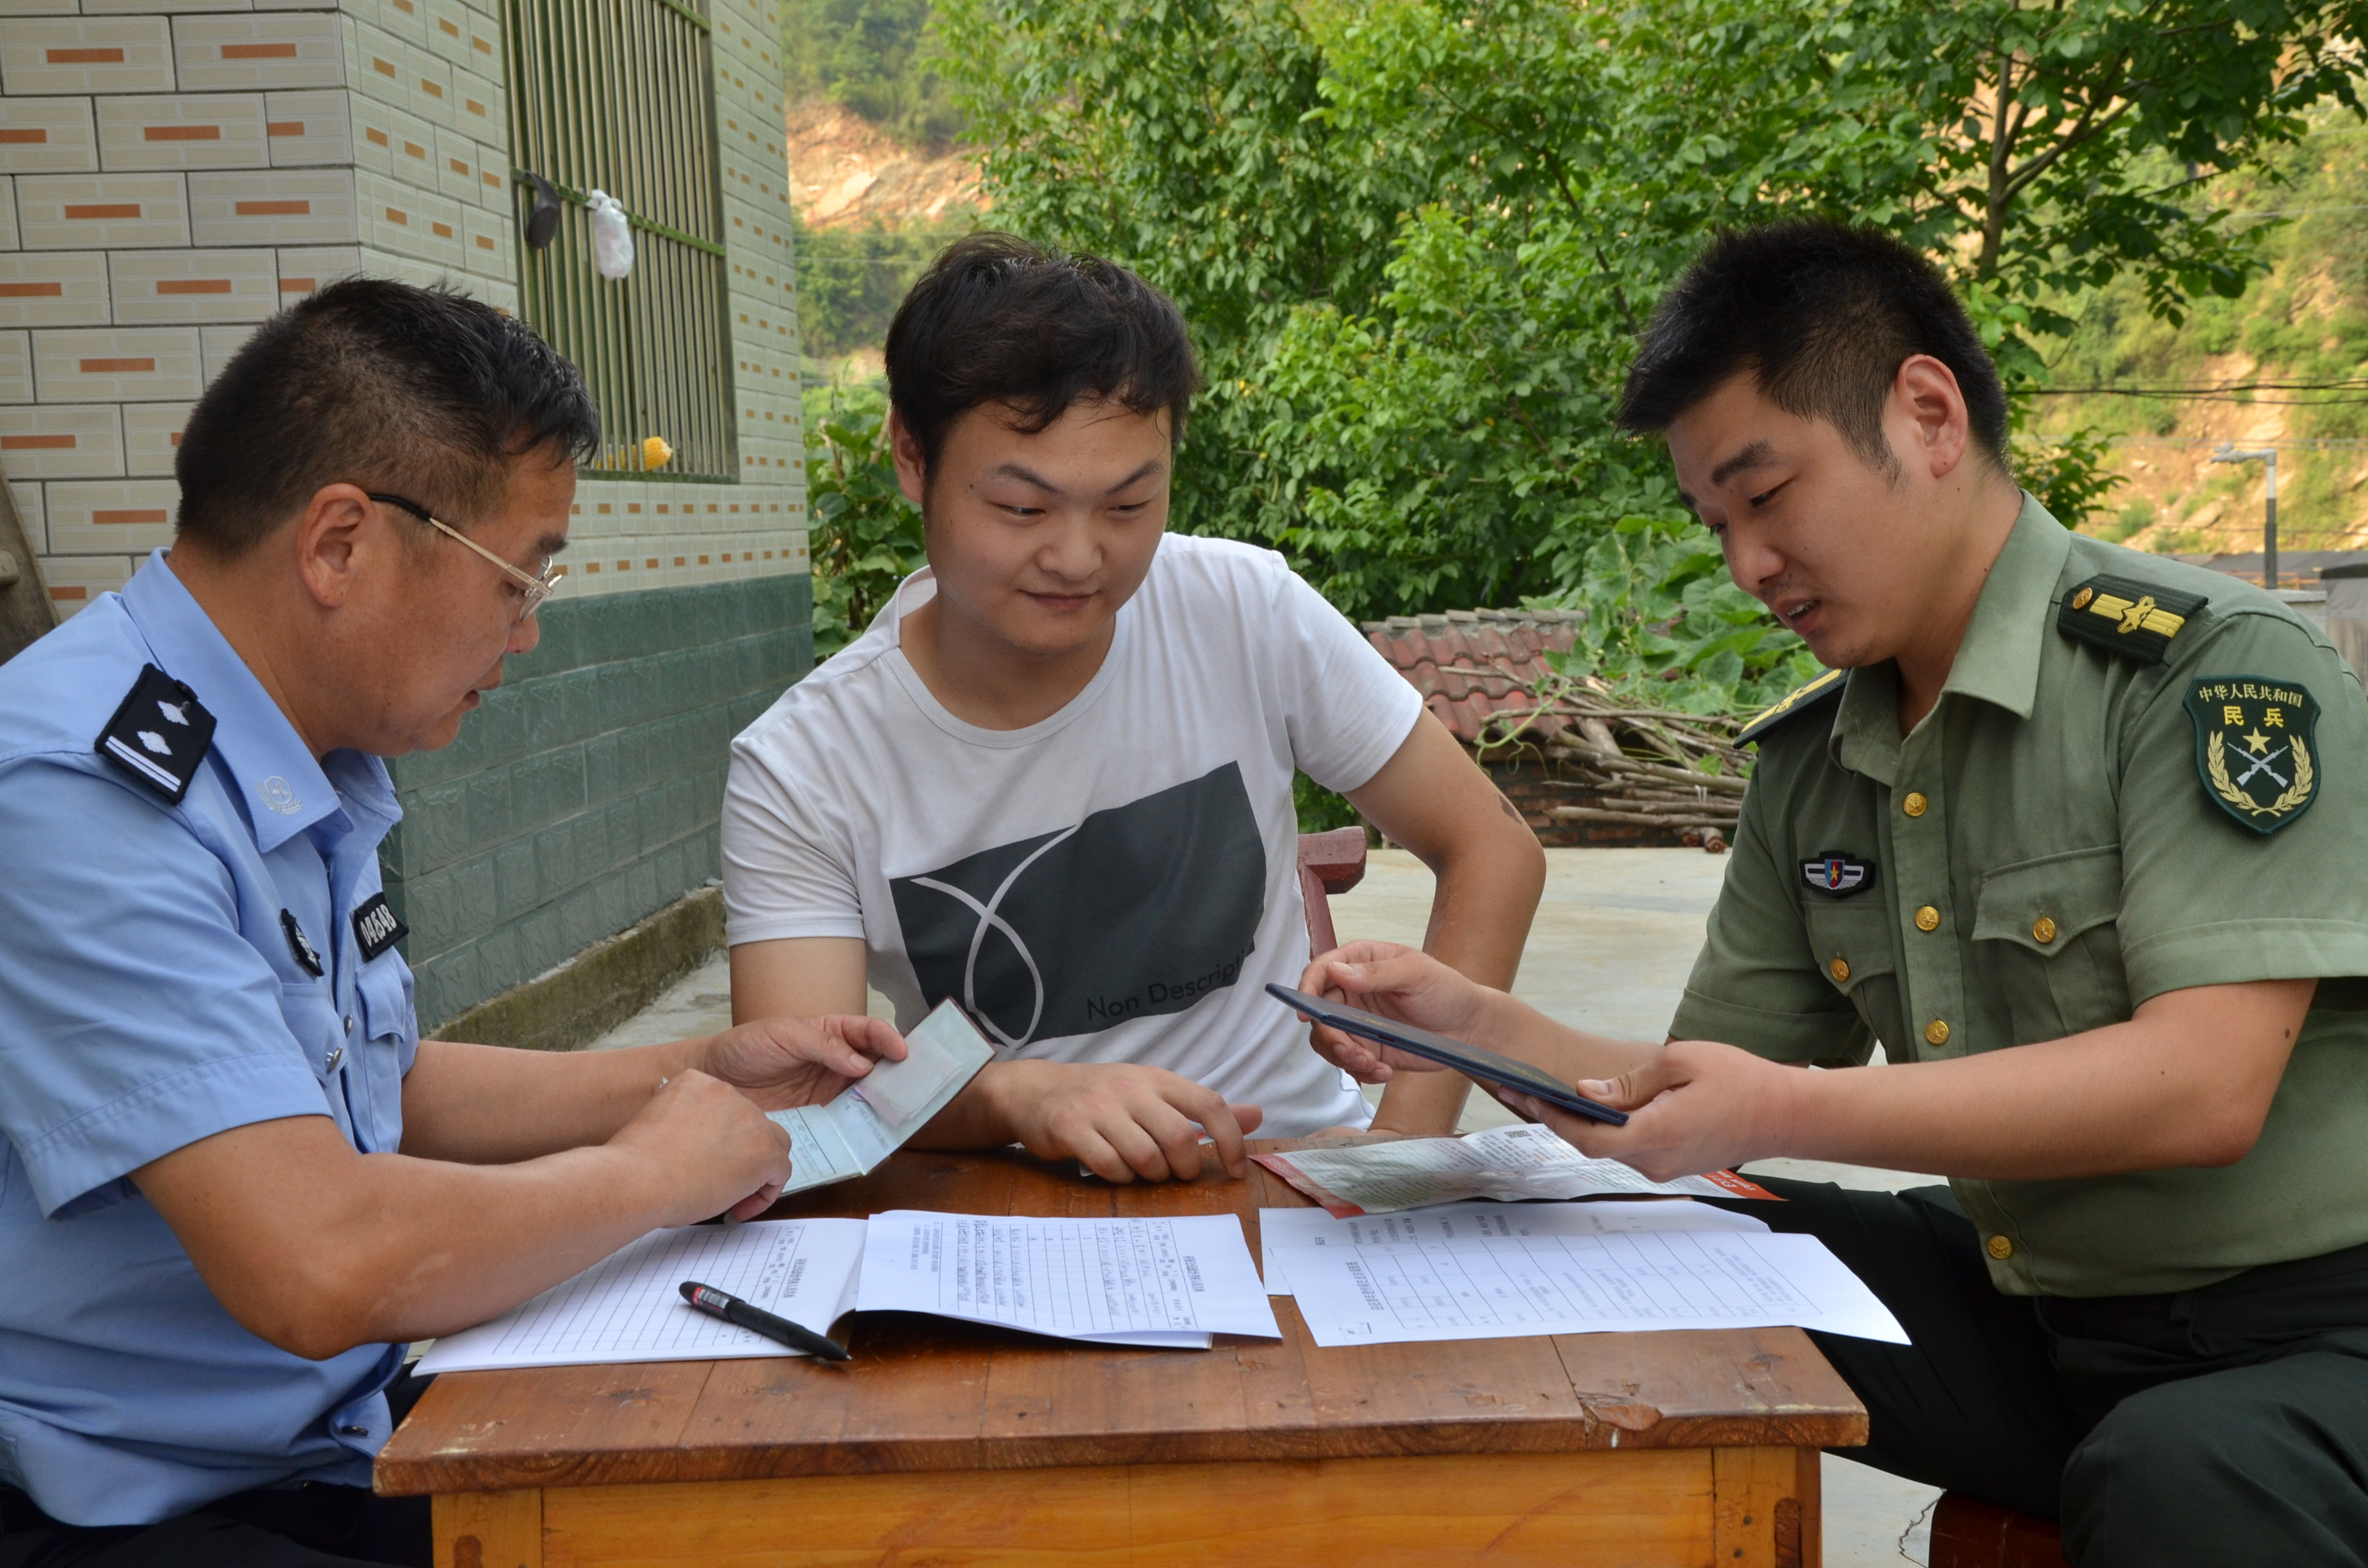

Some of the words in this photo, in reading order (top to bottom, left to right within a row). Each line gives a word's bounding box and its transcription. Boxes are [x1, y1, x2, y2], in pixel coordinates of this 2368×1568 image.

[2198, 683, 2303, 708] 中华人民共和国
[1087, 996, 1140, 1020] Non
